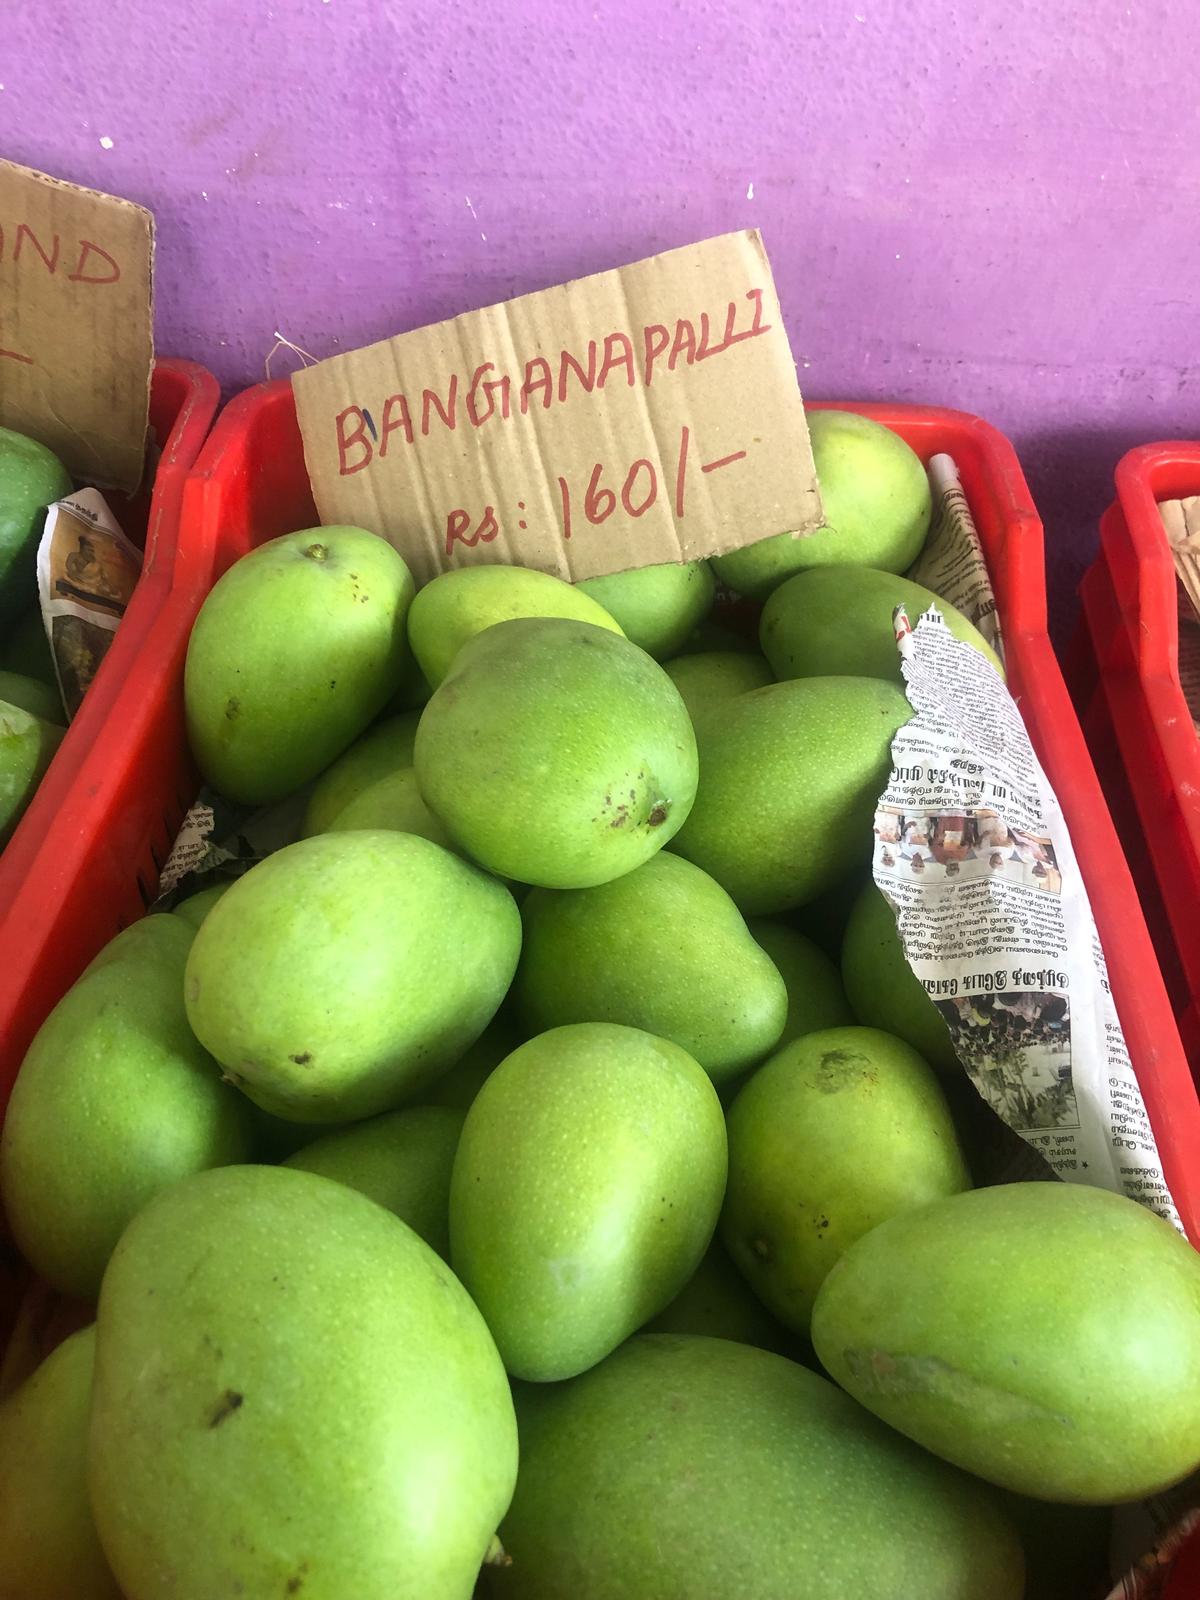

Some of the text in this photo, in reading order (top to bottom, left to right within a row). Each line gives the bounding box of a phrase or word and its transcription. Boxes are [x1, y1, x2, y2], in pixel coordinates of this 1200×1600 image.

[0, 223, 121, 284] ND
[335, 288, 771, 476] BANGANAPALLI
[558, 426, 747, 539] 160/-
[962, 969, 1008, 992] இயேசு
[1012, 968, 1069, 990] குழந்தை
